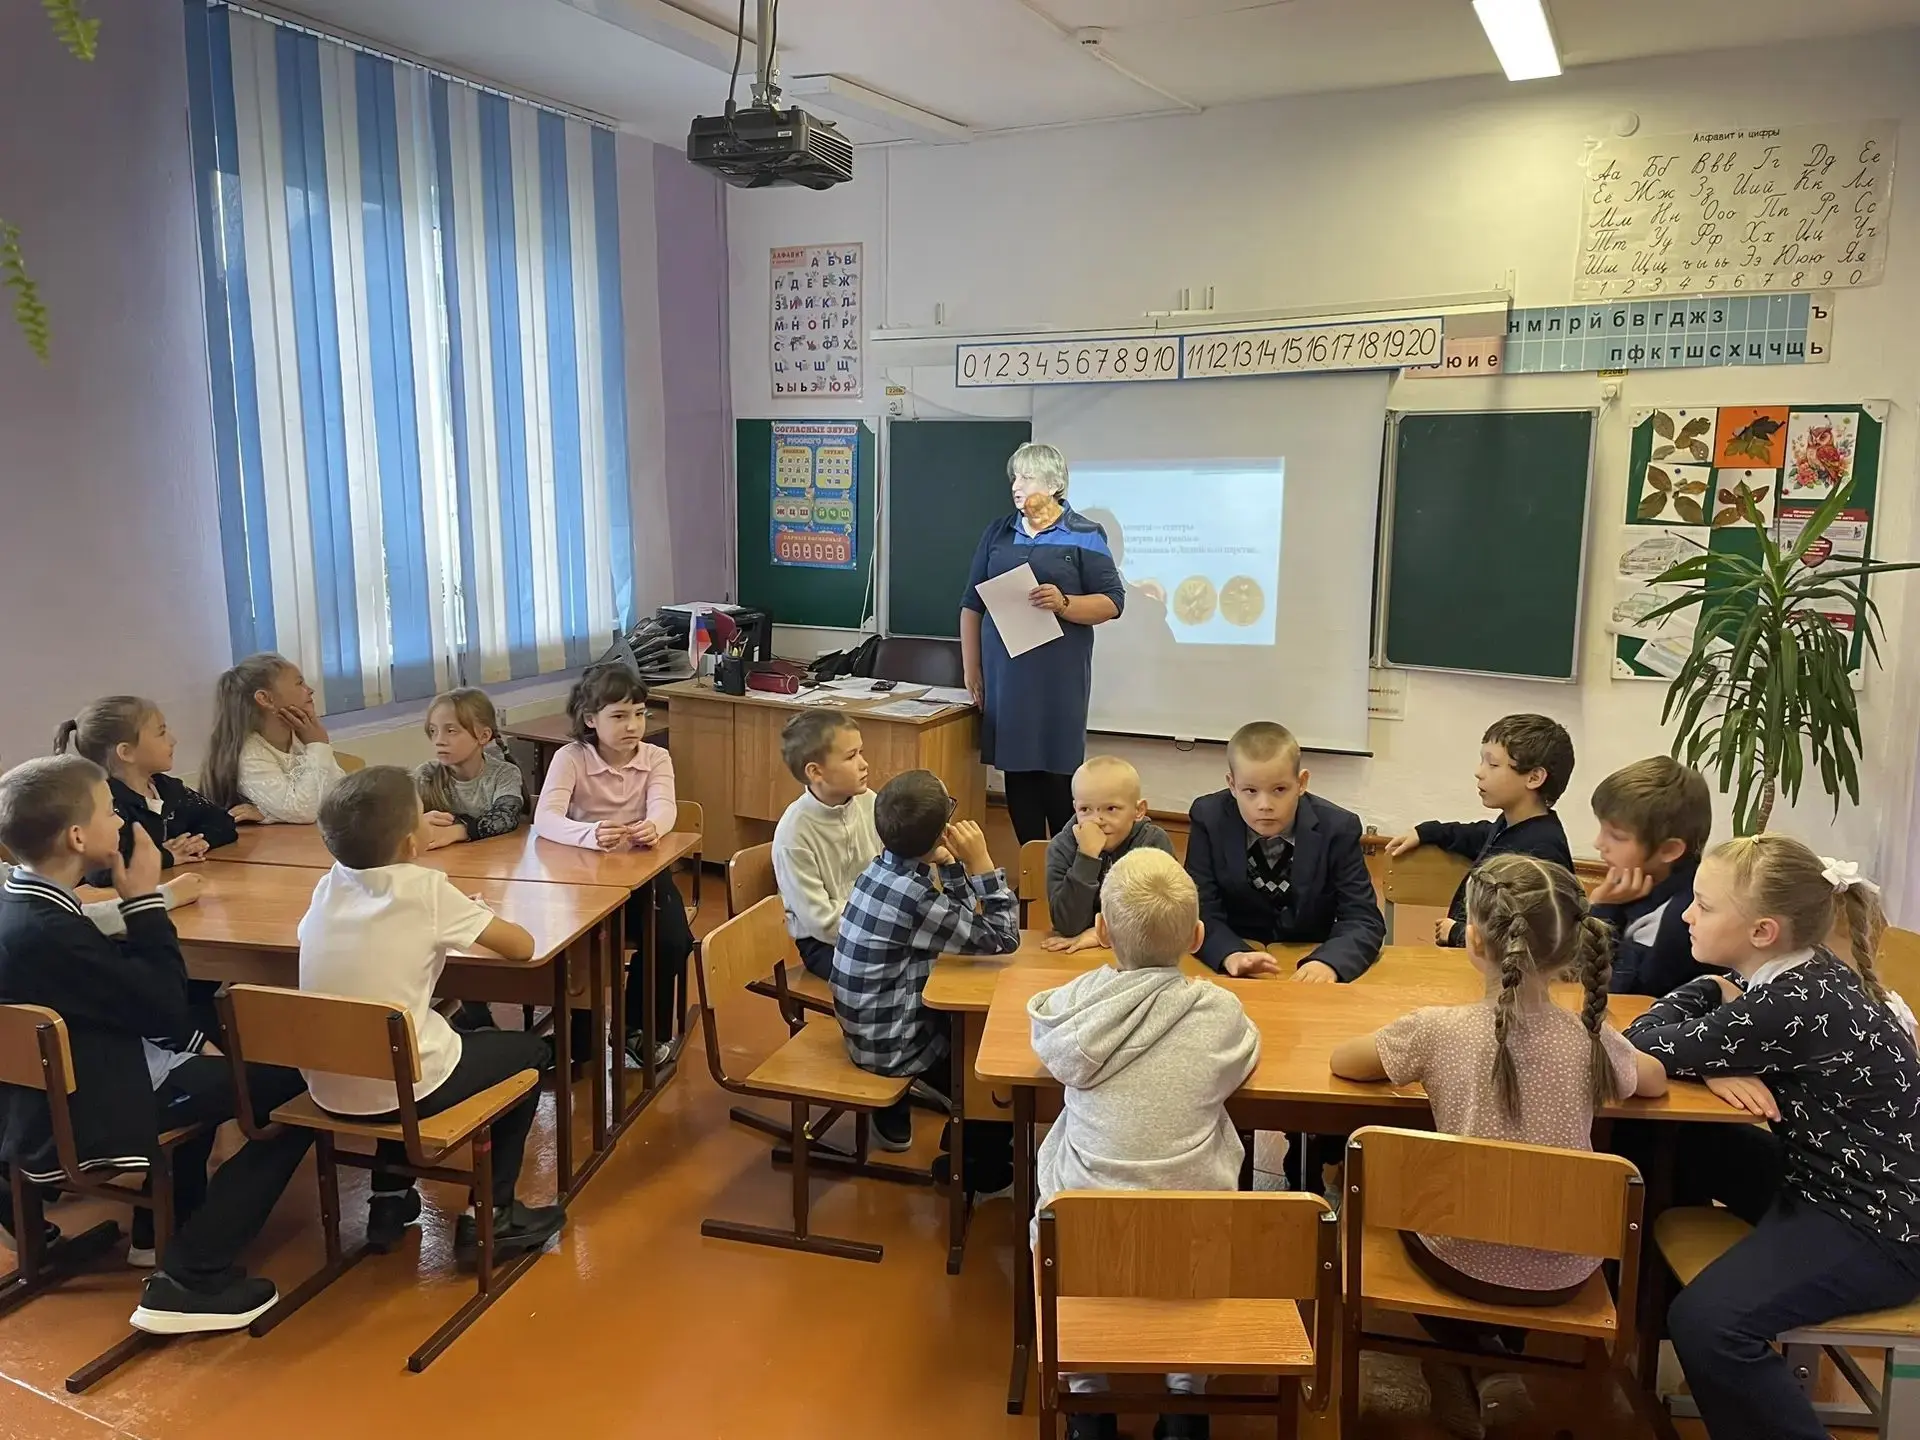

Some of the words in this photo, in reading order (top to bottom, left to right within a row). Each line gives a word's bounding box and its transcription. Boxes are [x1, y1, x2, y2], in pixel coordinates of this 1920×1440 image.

[1693, 131, 1736, 143] Алфавит
[1748, 129, 1780, 140] цифры
[1593, 159, 1622, 181] Аа
[1643, 155, 1680, 177] Бб
[1691, 152, 1737, 174] Ввв
[1753, 145, 1782, 169] Гг
[1803, 143, 1837, 175] Дд
[1858, 140, 1881, 163] Ее
[1624, 179, 1676, 202] Жж
[1690, 176, 1714, 206] Зз
[1733, 173, 1774, 195] Иий
[1794, 169, 1823, 190] Кк
[1841, 168, 1874, 189] Лл
[1590, 206, 1632, 228] Мм
[1650, 202, 1681, 224] Нн
[1703, 200, 1737, 220] Ооо
[1754, 193, 1790, 218] Пп
[1811, 192, 1840, 224] Рр
[1854, 191, 1877, 213] Сс
[1587, 229, 1627, 252] Тт
[1649, 226, 1672, 255] Уу
[1691, 223, 1723, 254] Фф
[1740, 221, 1775, 243] Хх
[1795, 218, 1823, 242] Цц
[1854, 216, 1877, 238] Чч
[1585, 253, 1618, 275] Шш
[1631, 251, 1668, 275] Щщ
[1600, 281, 1608, 295] 1
[1622, 280, 1635, 294] 2
[1650, 278, 1662, 292] 3
[1679, 276, 1691, 290] 4
[1705, 275, 1718, 289] 5
[1734, 274, 1744, 288] 6
[1763, 273, 1774, 287] 7
[1791, 272, 1803, 287] 8
[1820, 271, 1833, 285] 9
[1850, 269, 1862, 285] 0
[1509, 321, 1519, 333] н
[1527, 320, 1541, 332] м
[1547, 319, 1560, 331] л
[1570, 317, 1581, 334] р
[1590, 312, 1601, 329] й
[1613, 310, 1626, 327] б
[1633, 314, 1645, 326] в
[1654, 313, 1664, 326] г
[1670, 312, 1684, 327] д
[1689, 311, 1707, 324] ж
[1712, 310, 1723, 323] з
[1447, 356, 1461, 368] ю
[1468, 355, 1478, 367] и
[1488, 354, 1498, 366] е
[1611, 348, 1622, 361] п
[1628, 344, 1645, 364] ф
[1651, 347, 1661, 359] к
[1670, 346, 1681, 358] т
[1687, 346, 1703, 358] ш
[1710, 345, 1721, 357] с
[1728, 344, 1741, 357] х
[1749, 344, 1761, 359] ц
[1770, 343, 1781, 355] ч
[1787, 342, 1804, 357] щ
[827, 426, 855, 434] ЗВУКИ
